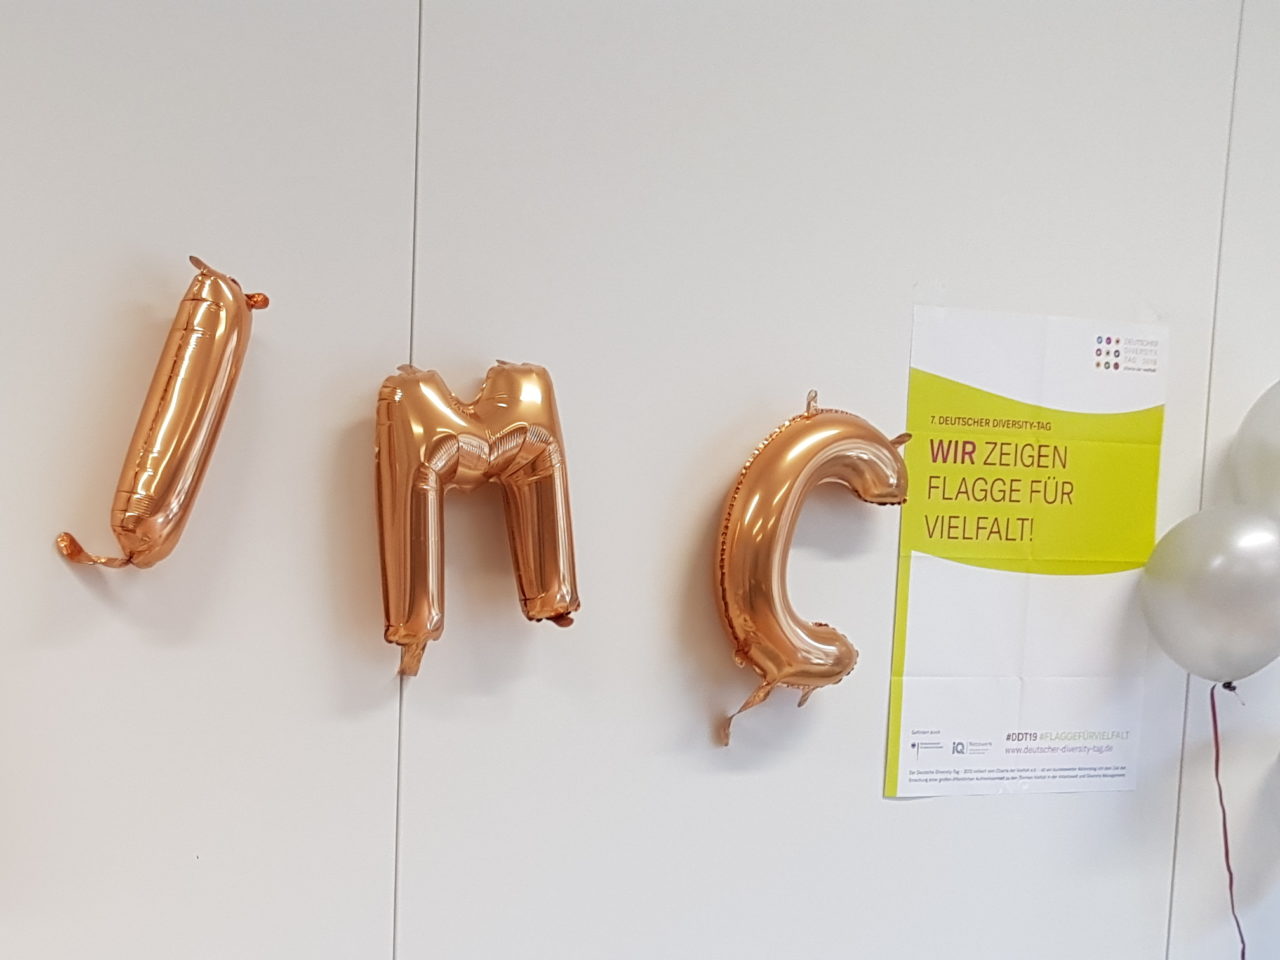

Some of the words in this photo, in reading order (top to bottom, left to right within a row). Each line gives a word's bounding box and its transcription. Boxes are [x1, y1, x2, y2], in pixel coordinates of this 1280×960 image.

[930, 415, 937, 425] 7.
[938, 416, 990, 428] DEUTSCHER
[992, 419, 1052, 431] DIVERSITY-TAG
[929, 438, 977, 465] WIR
[983, 441, 1068, 469] ZEIGEN
[927, 475, 1022, 504] FLAGGE
[1030, 476, 1074, 505] FÜR
[375, 360, 581, 645] M
[718, 402, 910, 690] C
[924, 514, 1034, 542] VIELFALT!
[1005, 732, 1038, 742] #DDT19
